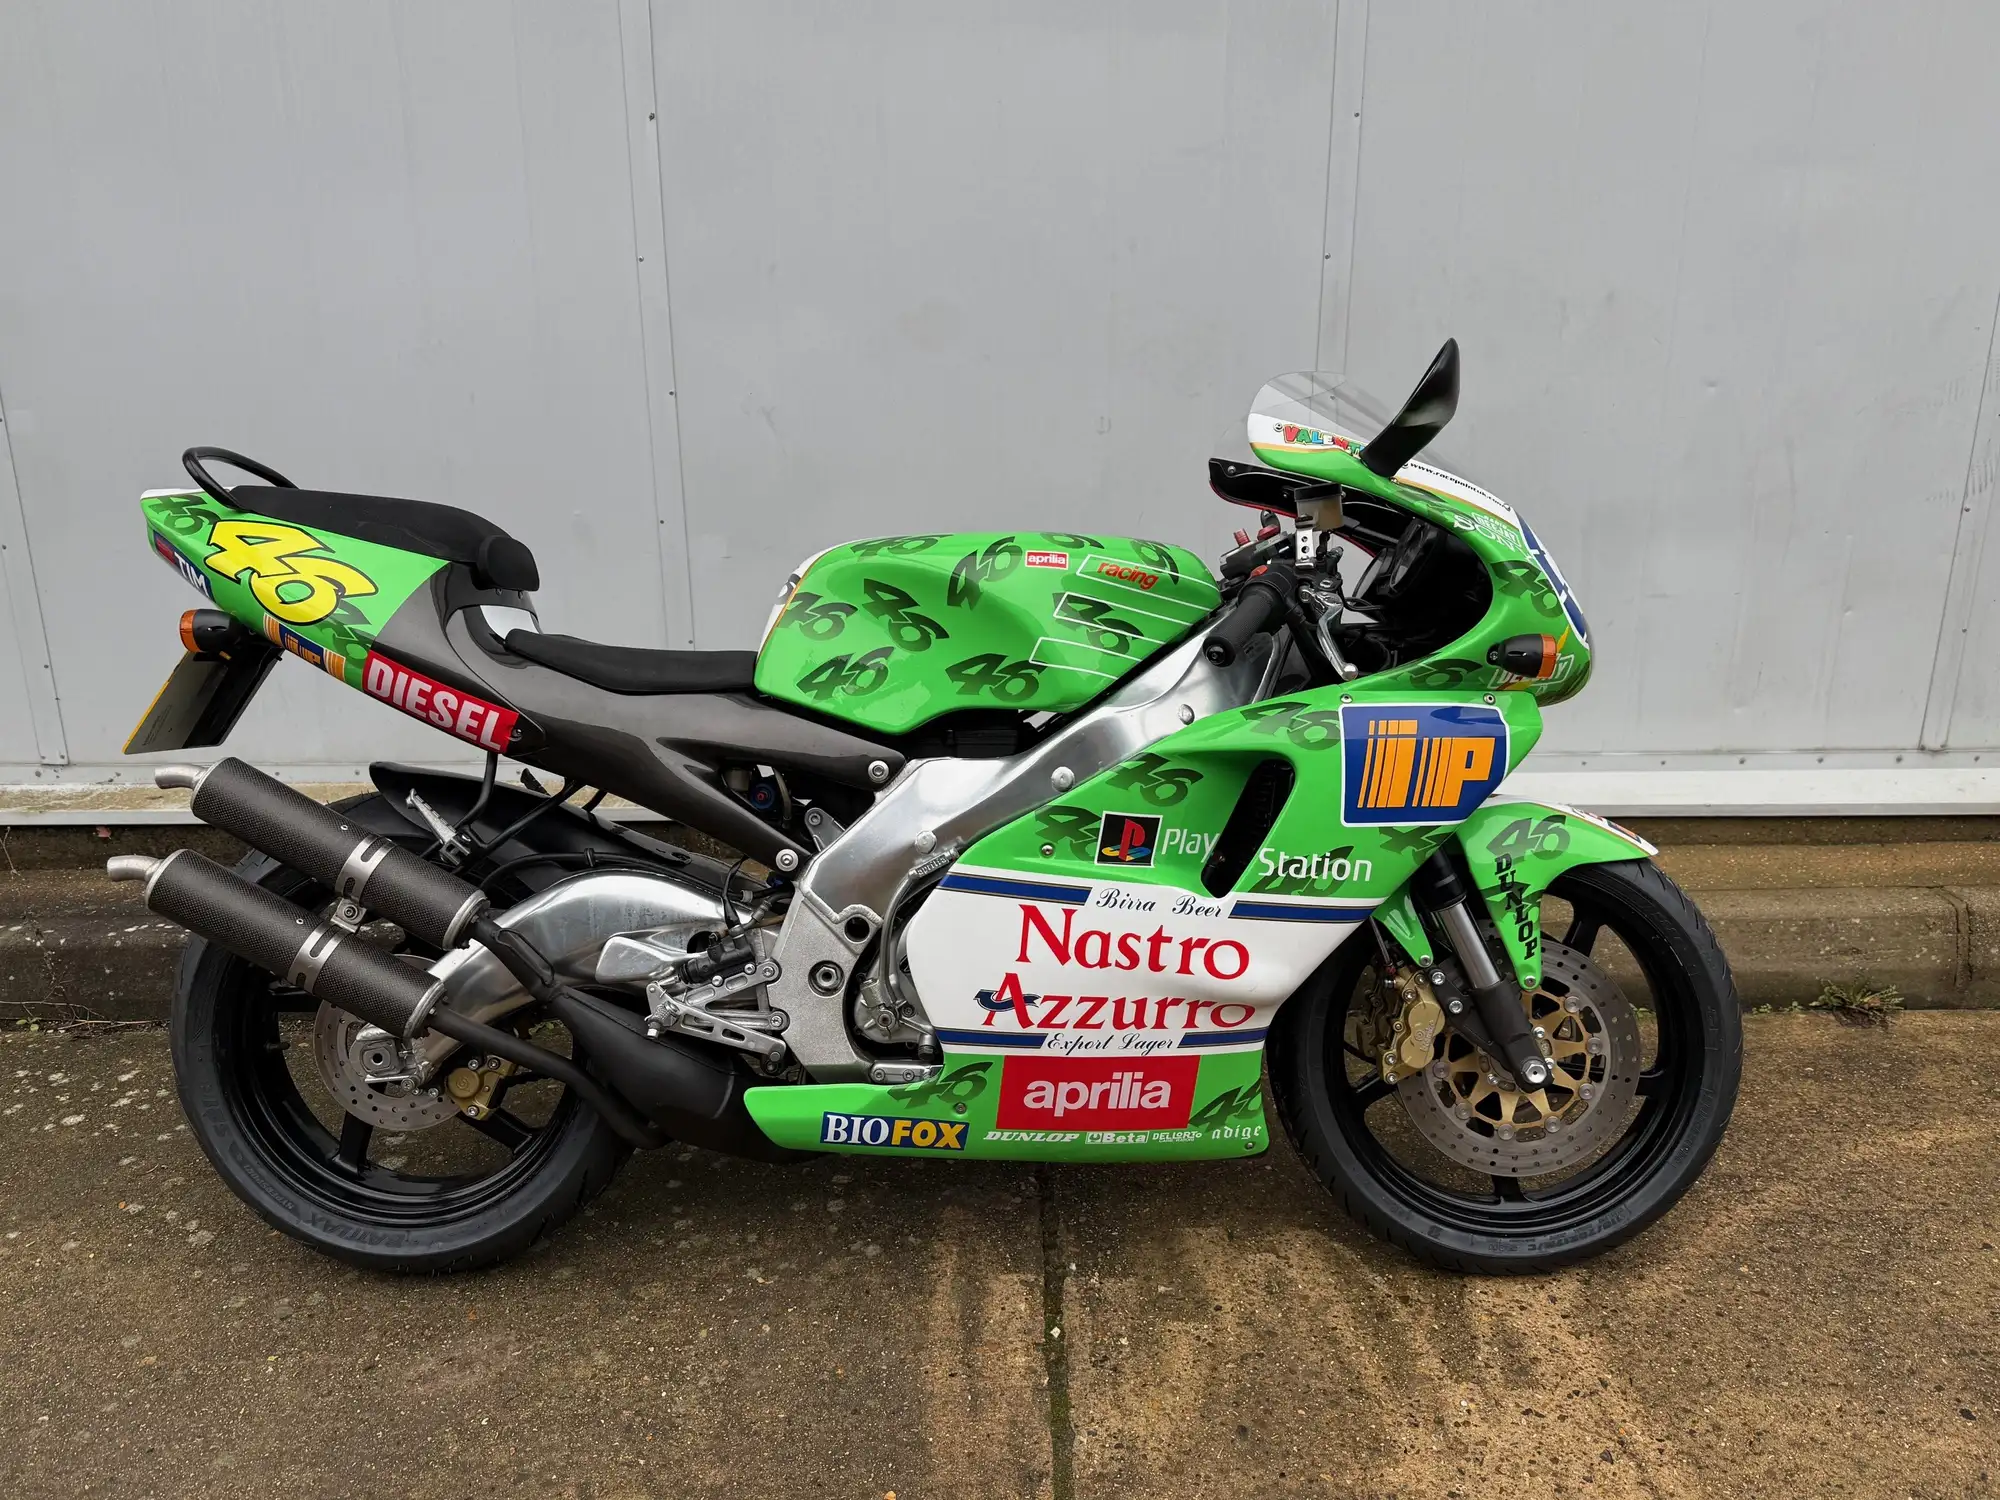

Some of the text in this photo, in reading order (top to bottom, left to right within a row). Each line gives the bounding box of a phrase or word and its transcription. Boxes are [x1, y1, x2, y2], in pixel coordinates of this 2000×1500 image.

[174, 551, 210, 598] TIM
[204, 519, 379, 626] 46
[947, 536, 1023, 610] 46
[1028, 554, 1066, 566] aprilia
[1097, 561, 1159, 591] racing
[863, 578, 950, 652] 46
[1052, 592, 1145, 655] 46
[796, 646, 895, 701] 46
[945, 653, 1049, 703] 46
[367, 658, 501, 751] DIESEL
[1241, 702, 1341, 750] 46
[1106, 753, 1203, 806] 46
[1161, 828, 1372, 882] Play Station
[1487, 815, 1570, 864] 46
[1096, 888, 1224, 918] Birra Beer
[1495, 853, 1538, 960] DUNLOP
[1016, 904, 1250, 981] Nastro
[981, 972, 1256, 1031] Azzurro
[1047, 1032, 1174, 1057] Export Lager
[887, 1062, 993, 1110] 46
[1024, 1071, 1172, 1117] aprilia
[983, 1131, 1080, 1143] DUNLOP
[1102, 1132, 1147, 1144] Beta
[1212, 1124, 1262, 1140] adige
